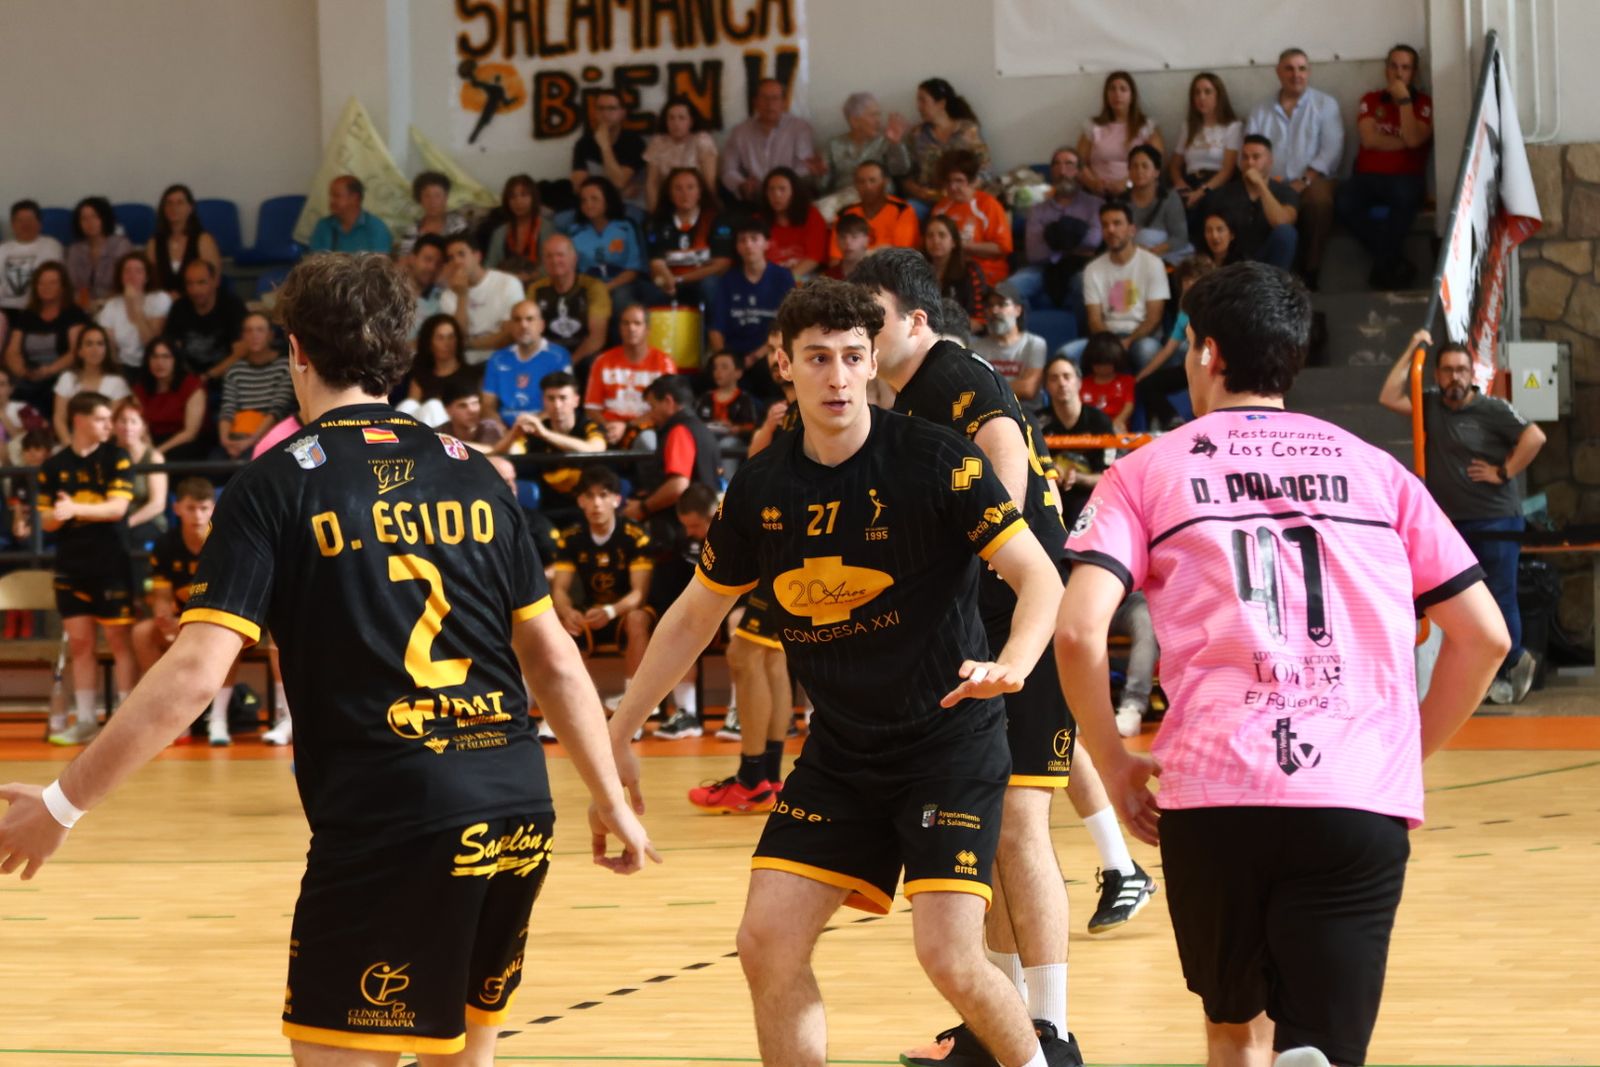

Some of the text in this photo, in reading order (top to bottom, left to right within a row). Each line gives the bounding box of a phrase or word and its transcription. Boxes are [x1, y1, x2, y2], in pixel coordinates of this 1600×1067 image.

[455, 0, 797, 59] SALAMANCA
[1227, 429, 1336, 442] Restaurante
[1229, 441, 1343, 457] Los Corzos
[1189, 471, 1349, 504] D. PALACIO
[806, 500, 841, 536] 27
[311, 498, 495, 558] D. EGIDO
[865, 531, 889, 541] 1995
[1231, 524, 1333, 648] 41
[387, 553, 473, 690] 2
[783, 610, 901, 643] CONGESA XXI
[939, 810, 981, 822] Ayuntamiento
[947, 819, 981, 830] Salamanca
[955, 865, 978, 876] errea
[348, 1008, 389, 1019] CLÍNICA
[348, 1017, 415, 1029] FISIOTERAPIA
